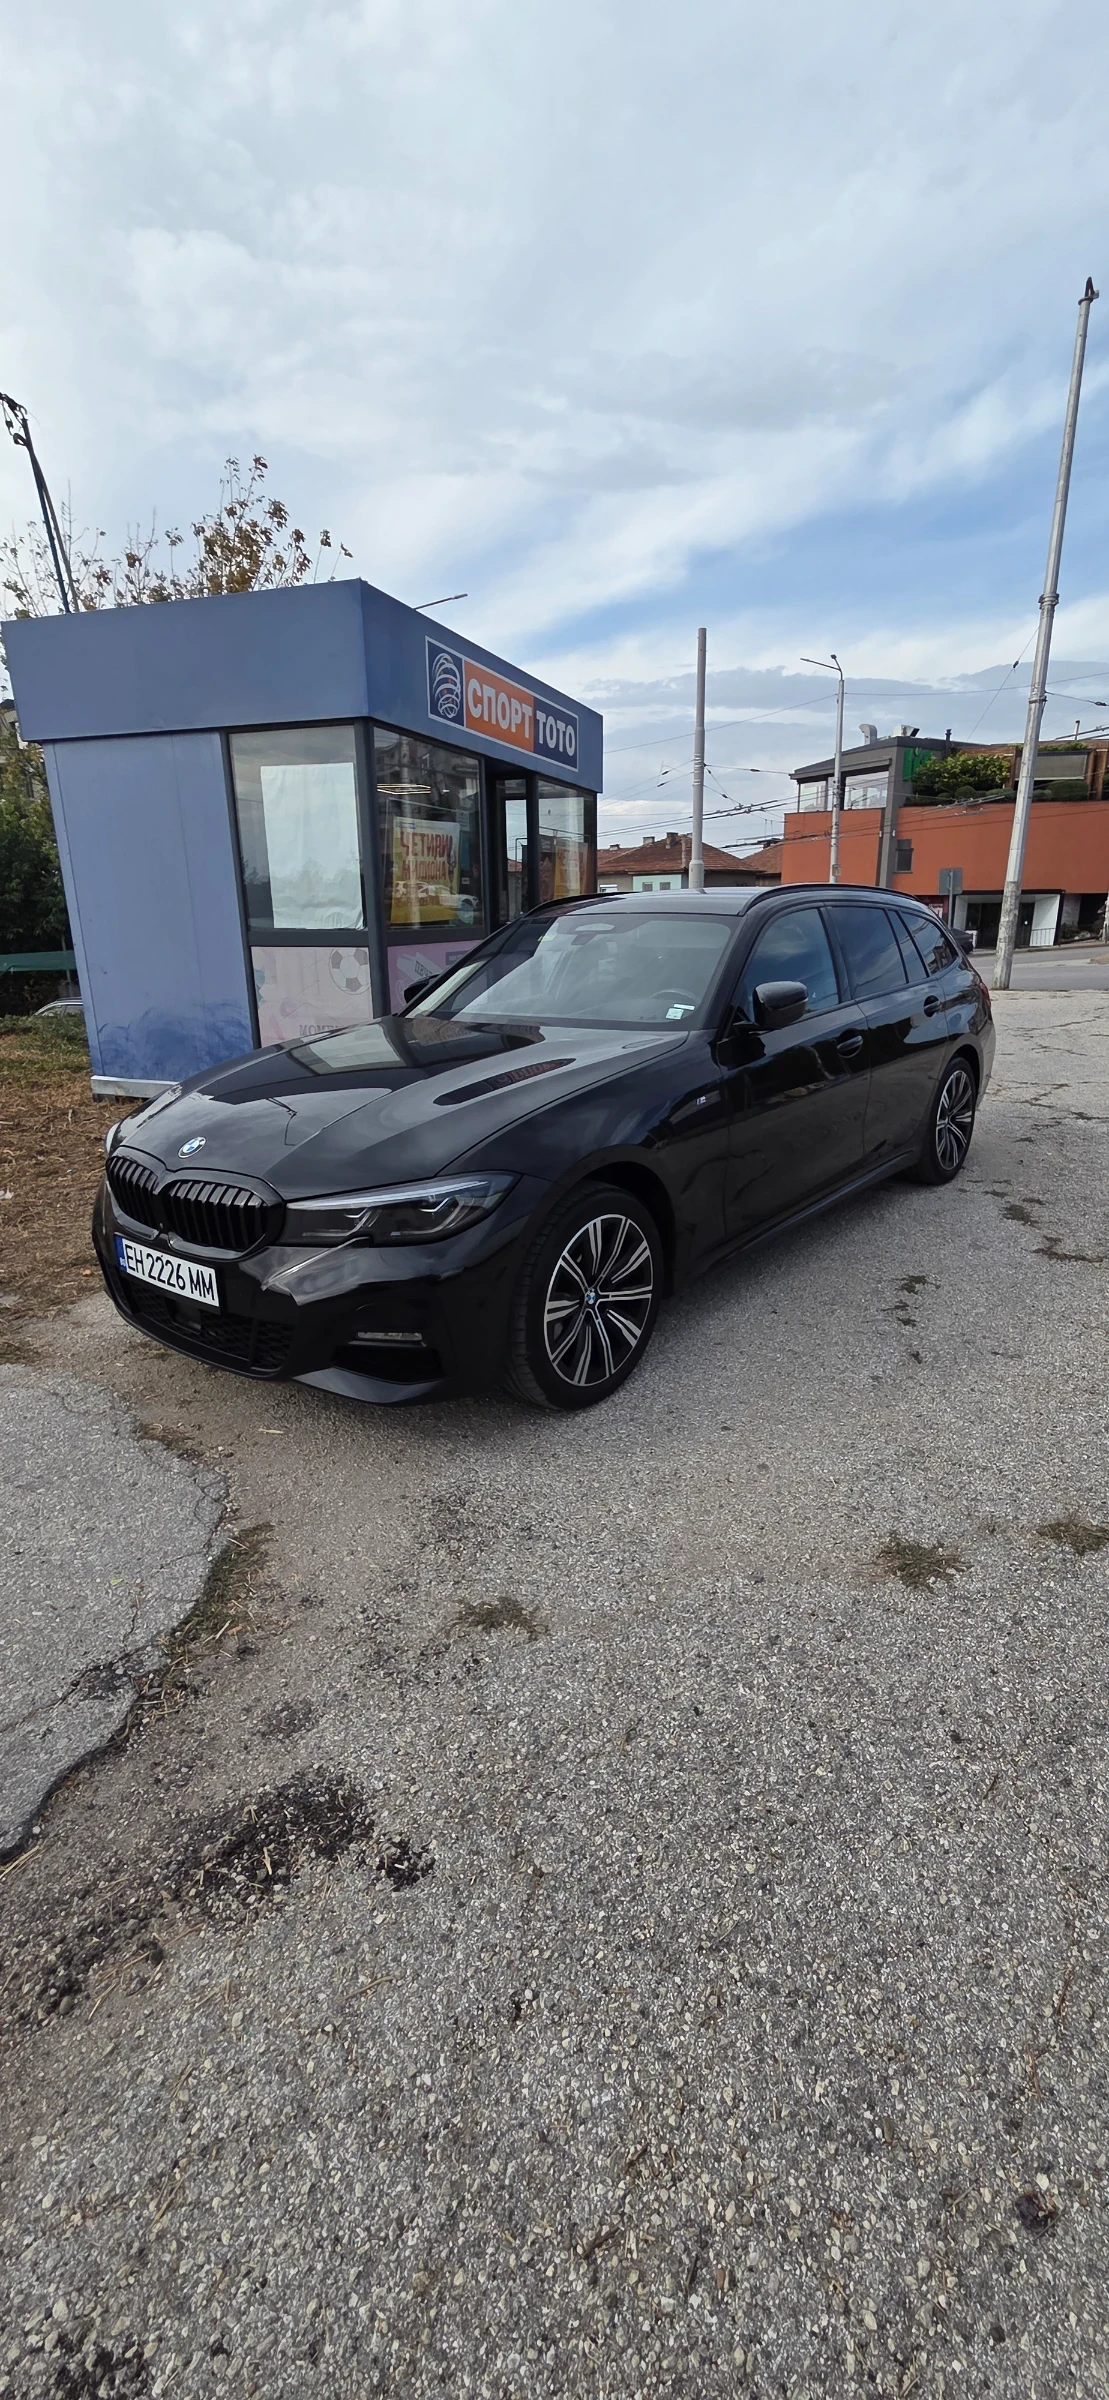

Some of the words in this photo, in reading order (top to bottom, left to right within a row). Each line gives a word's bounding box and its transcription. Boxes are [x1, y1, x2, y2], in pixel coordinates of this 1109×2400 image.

[467, 678, 532, 738] СПОРТ
[536, 710, 576, 756] ТОТО
[146, 1253, 186, 1290] 2226
[188, 1267, 215, 1300] MM
